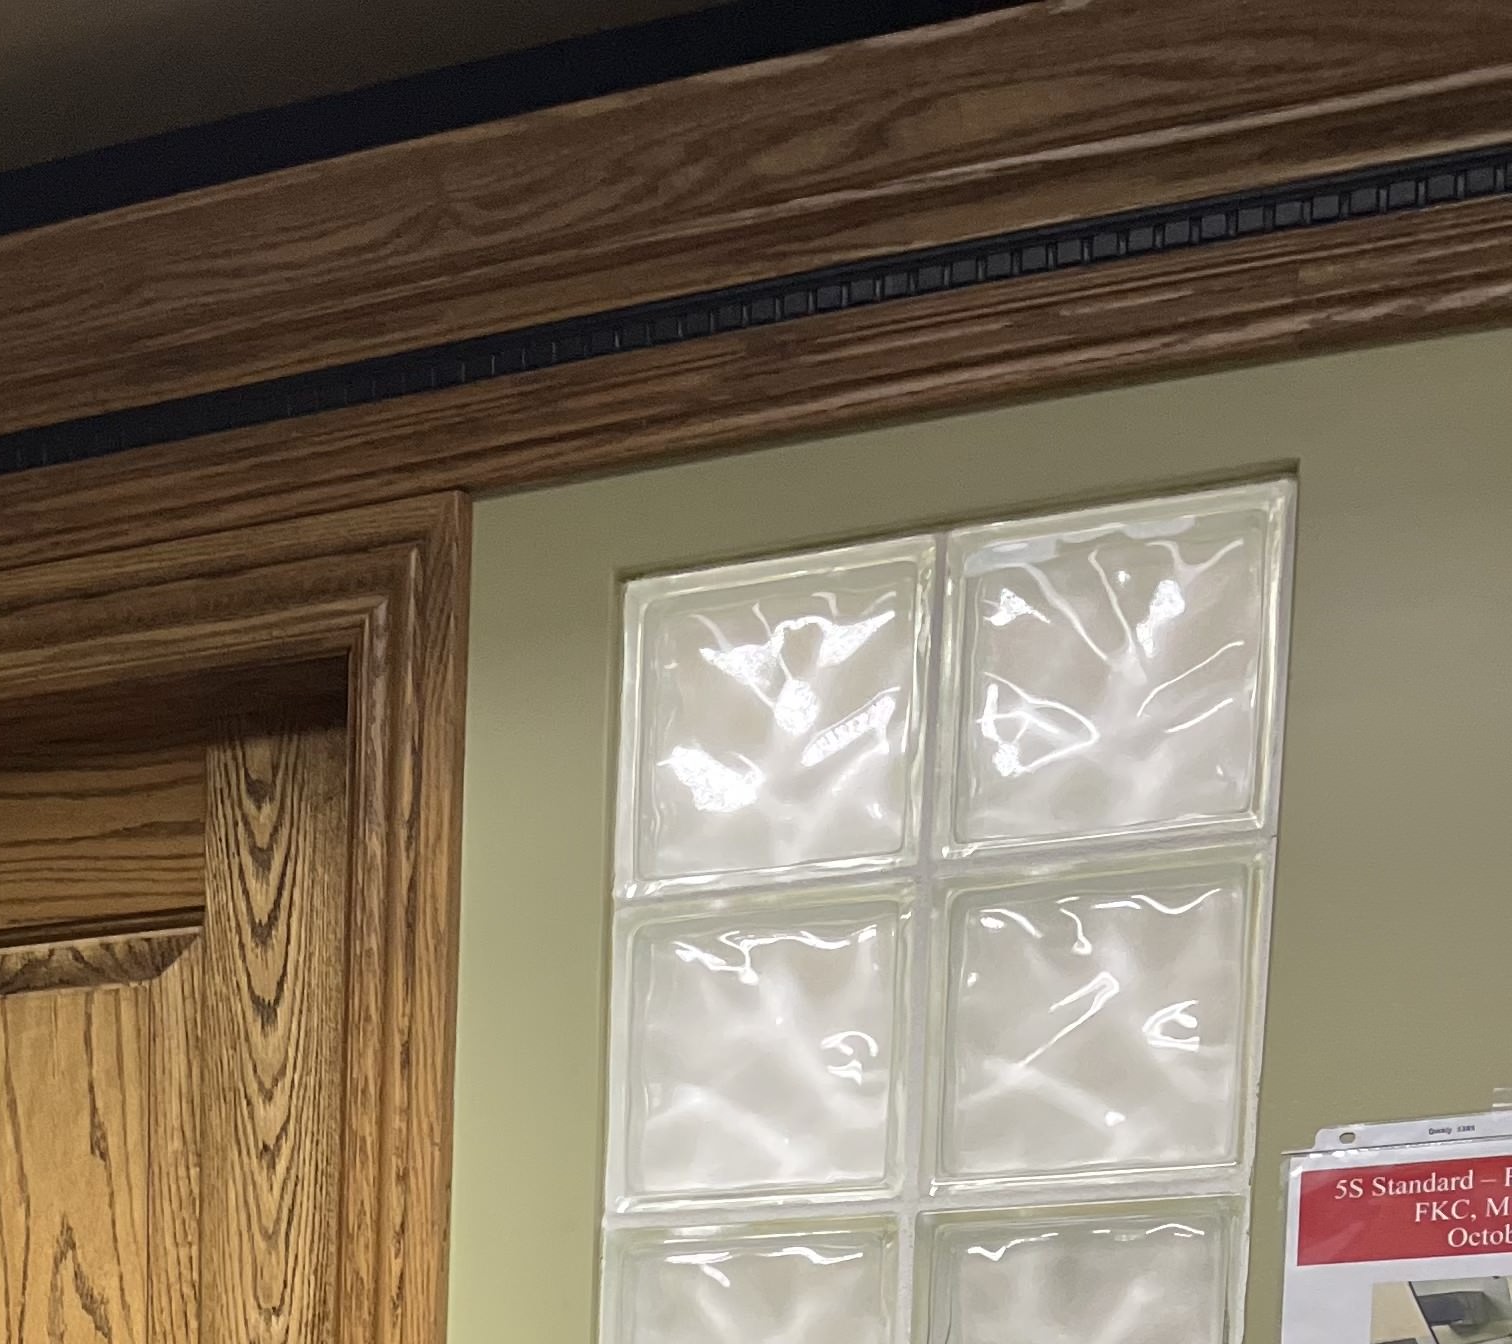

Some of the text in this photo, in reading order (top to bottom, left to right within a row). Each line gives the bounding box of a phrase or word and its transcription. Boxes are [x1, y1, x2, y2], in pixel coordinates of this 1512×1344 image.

[1334, 1177, 1364, 1200] 5S
[1371, 1169, 1474, 1198] Standard
[1414, 1198, 1477, 1223] FKC,
